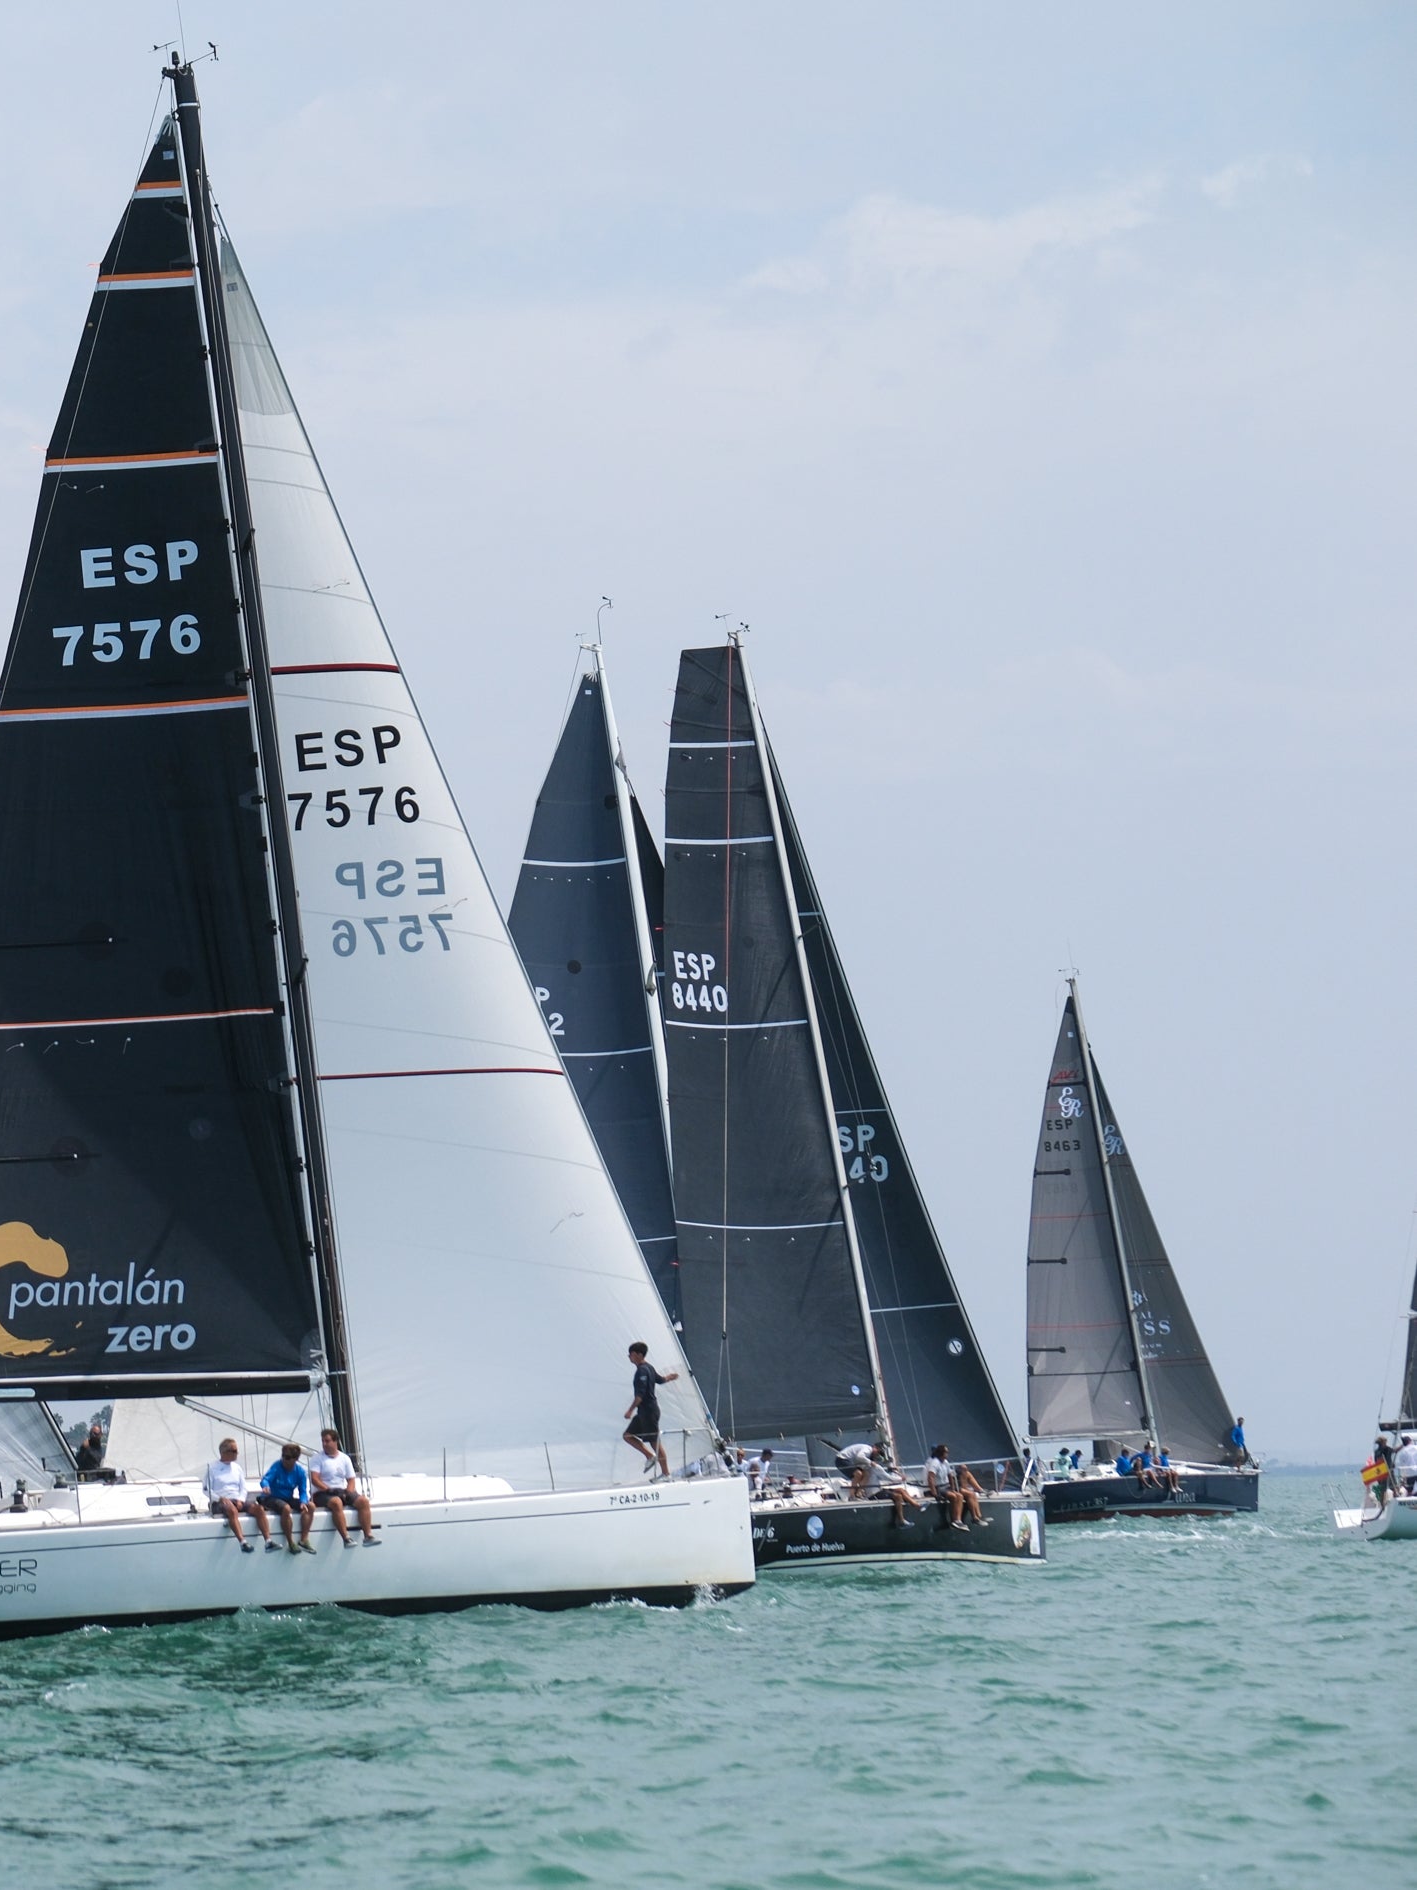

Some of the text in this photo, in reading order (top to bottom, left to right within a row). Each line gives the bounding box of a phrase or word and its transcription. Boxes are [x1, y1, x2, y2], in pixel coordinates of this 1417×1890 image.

[80, 539, 199, 589] ESP
[52, 613, 202, 666] 7576
[294, 725, 402, 772] ESP
[288, 786, 420, 832] 7576
[673, 951, 716, 981] ESP
[671, 982, 728, 1013] 8440
[837, 1124, 875, 1152] SP
[1047, 1119, 1073, 1131] ESP
[1044, 1140, 1081, 1152] 8463
[849, 1155, 888, 1182] 40
[8, 1262, 185, 1319] pantalán
[105, 1322, 196, 1353] zero
[786, 1541, 845, 1554] Puerto de Huelva
